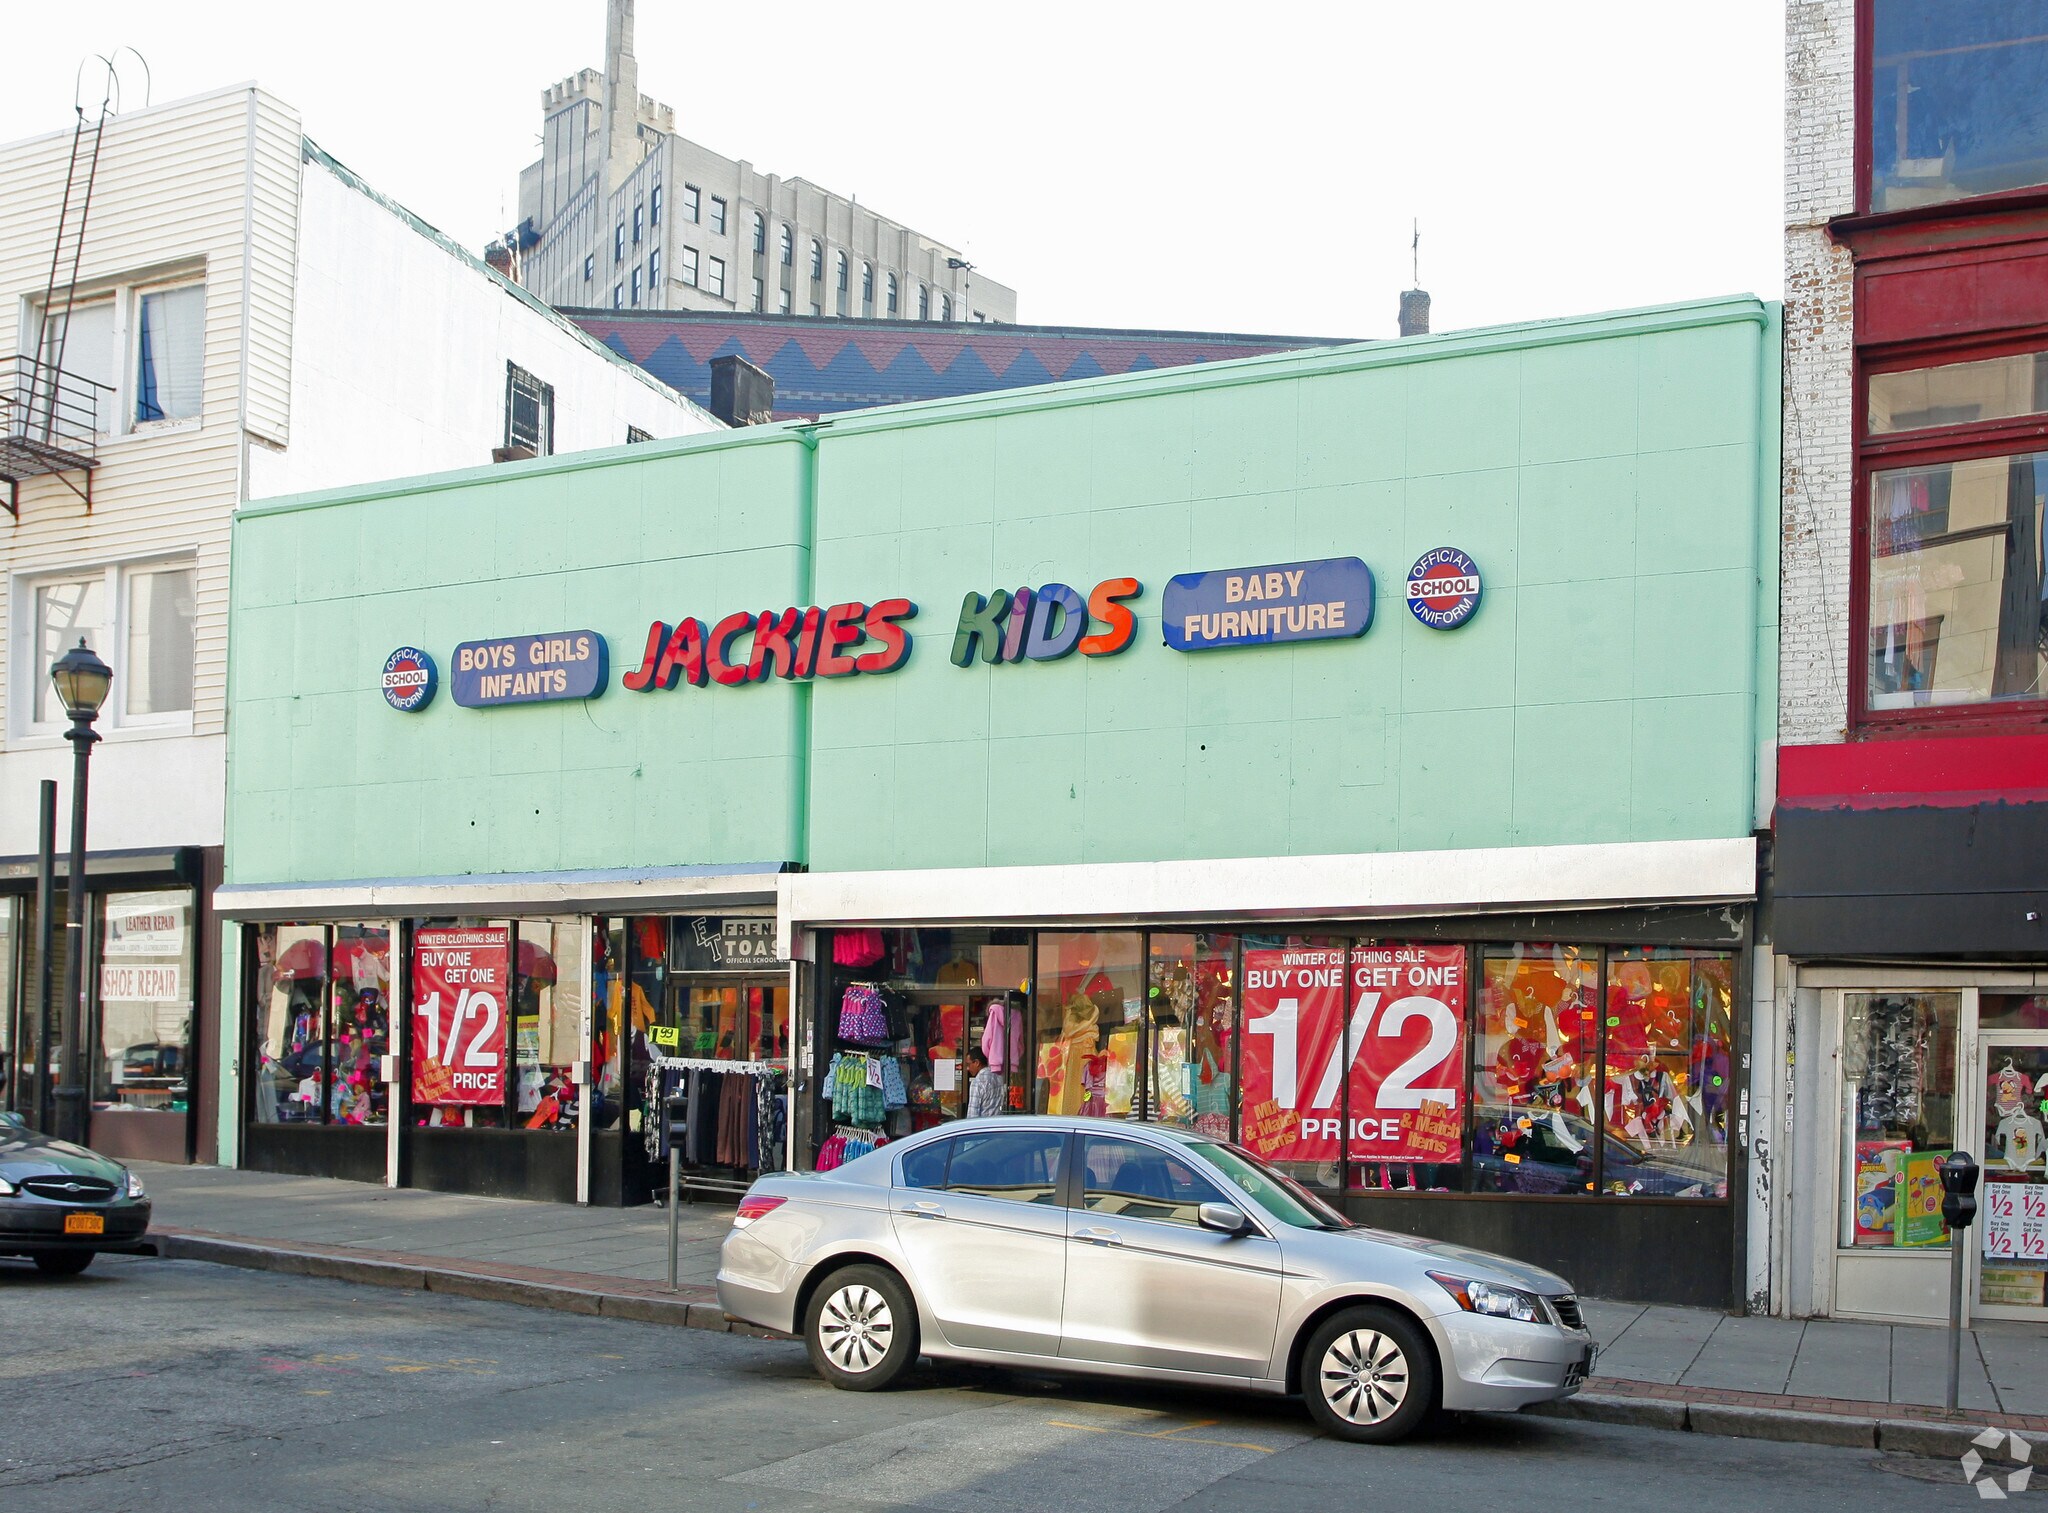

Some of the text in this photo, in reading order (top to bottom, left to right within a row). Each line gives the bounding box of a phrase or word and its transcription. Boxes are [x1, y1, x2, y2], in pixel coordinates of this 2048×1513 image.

[1413, 550, 1470, 577] OFFICIAL
[1226, 569, 1305, 604] BABY
[1410, 579, 1475, 597] SCHOOL
[1184, 601, 1346, 642] FURNITURE
[1413, 597, 1473, 624] UNIFORM
[622, 577, 1144, 692] JACKIES KIDS
[386, 648, 424, 671] OFFICIAL
[460, 637, 590, 671] BOYS GIRLS
[385, 672, 426, 686] SCHOOL
[480, 668, 567, 699] INFANTS
[386, 687, 425, 708] UNIFORM
[125, 915, 175, 931] LEATHER REPAIR
[418, 933, 505, 944] WINTER CLOTHING SALE
[421, 951, 471, 967] BUY ONE
[1282, 952, 1326, 965] WINTER
[1394, 950, 1426, 963] SALE
[103, 969, 176, 996] SHOE REPAIR
[444, 968, 495, 983] GET ONE
[965, 978, 976, 987] 10
[1247, 966, 1458, 989] BUY ONE GET ONE
[453, 1072, 497, 1089] PRICE
[1245, 1109, 1301, 1141] & Match
[1301, 1118, 1400, 1141] PRICE
[1399, 1112, 1461, 1139] & Match
[1256, 1128, 1298, 1154] Items
[1406, 1130, 1448, 1154] Items
[1990, 1193, 2013, 1216] 1/2
[2022, 1195, 2046, 1217] 1/2
[1988, 1231, 2012, 1253] 1/2
[2021, 1232, 2045, 1254] 1/2
